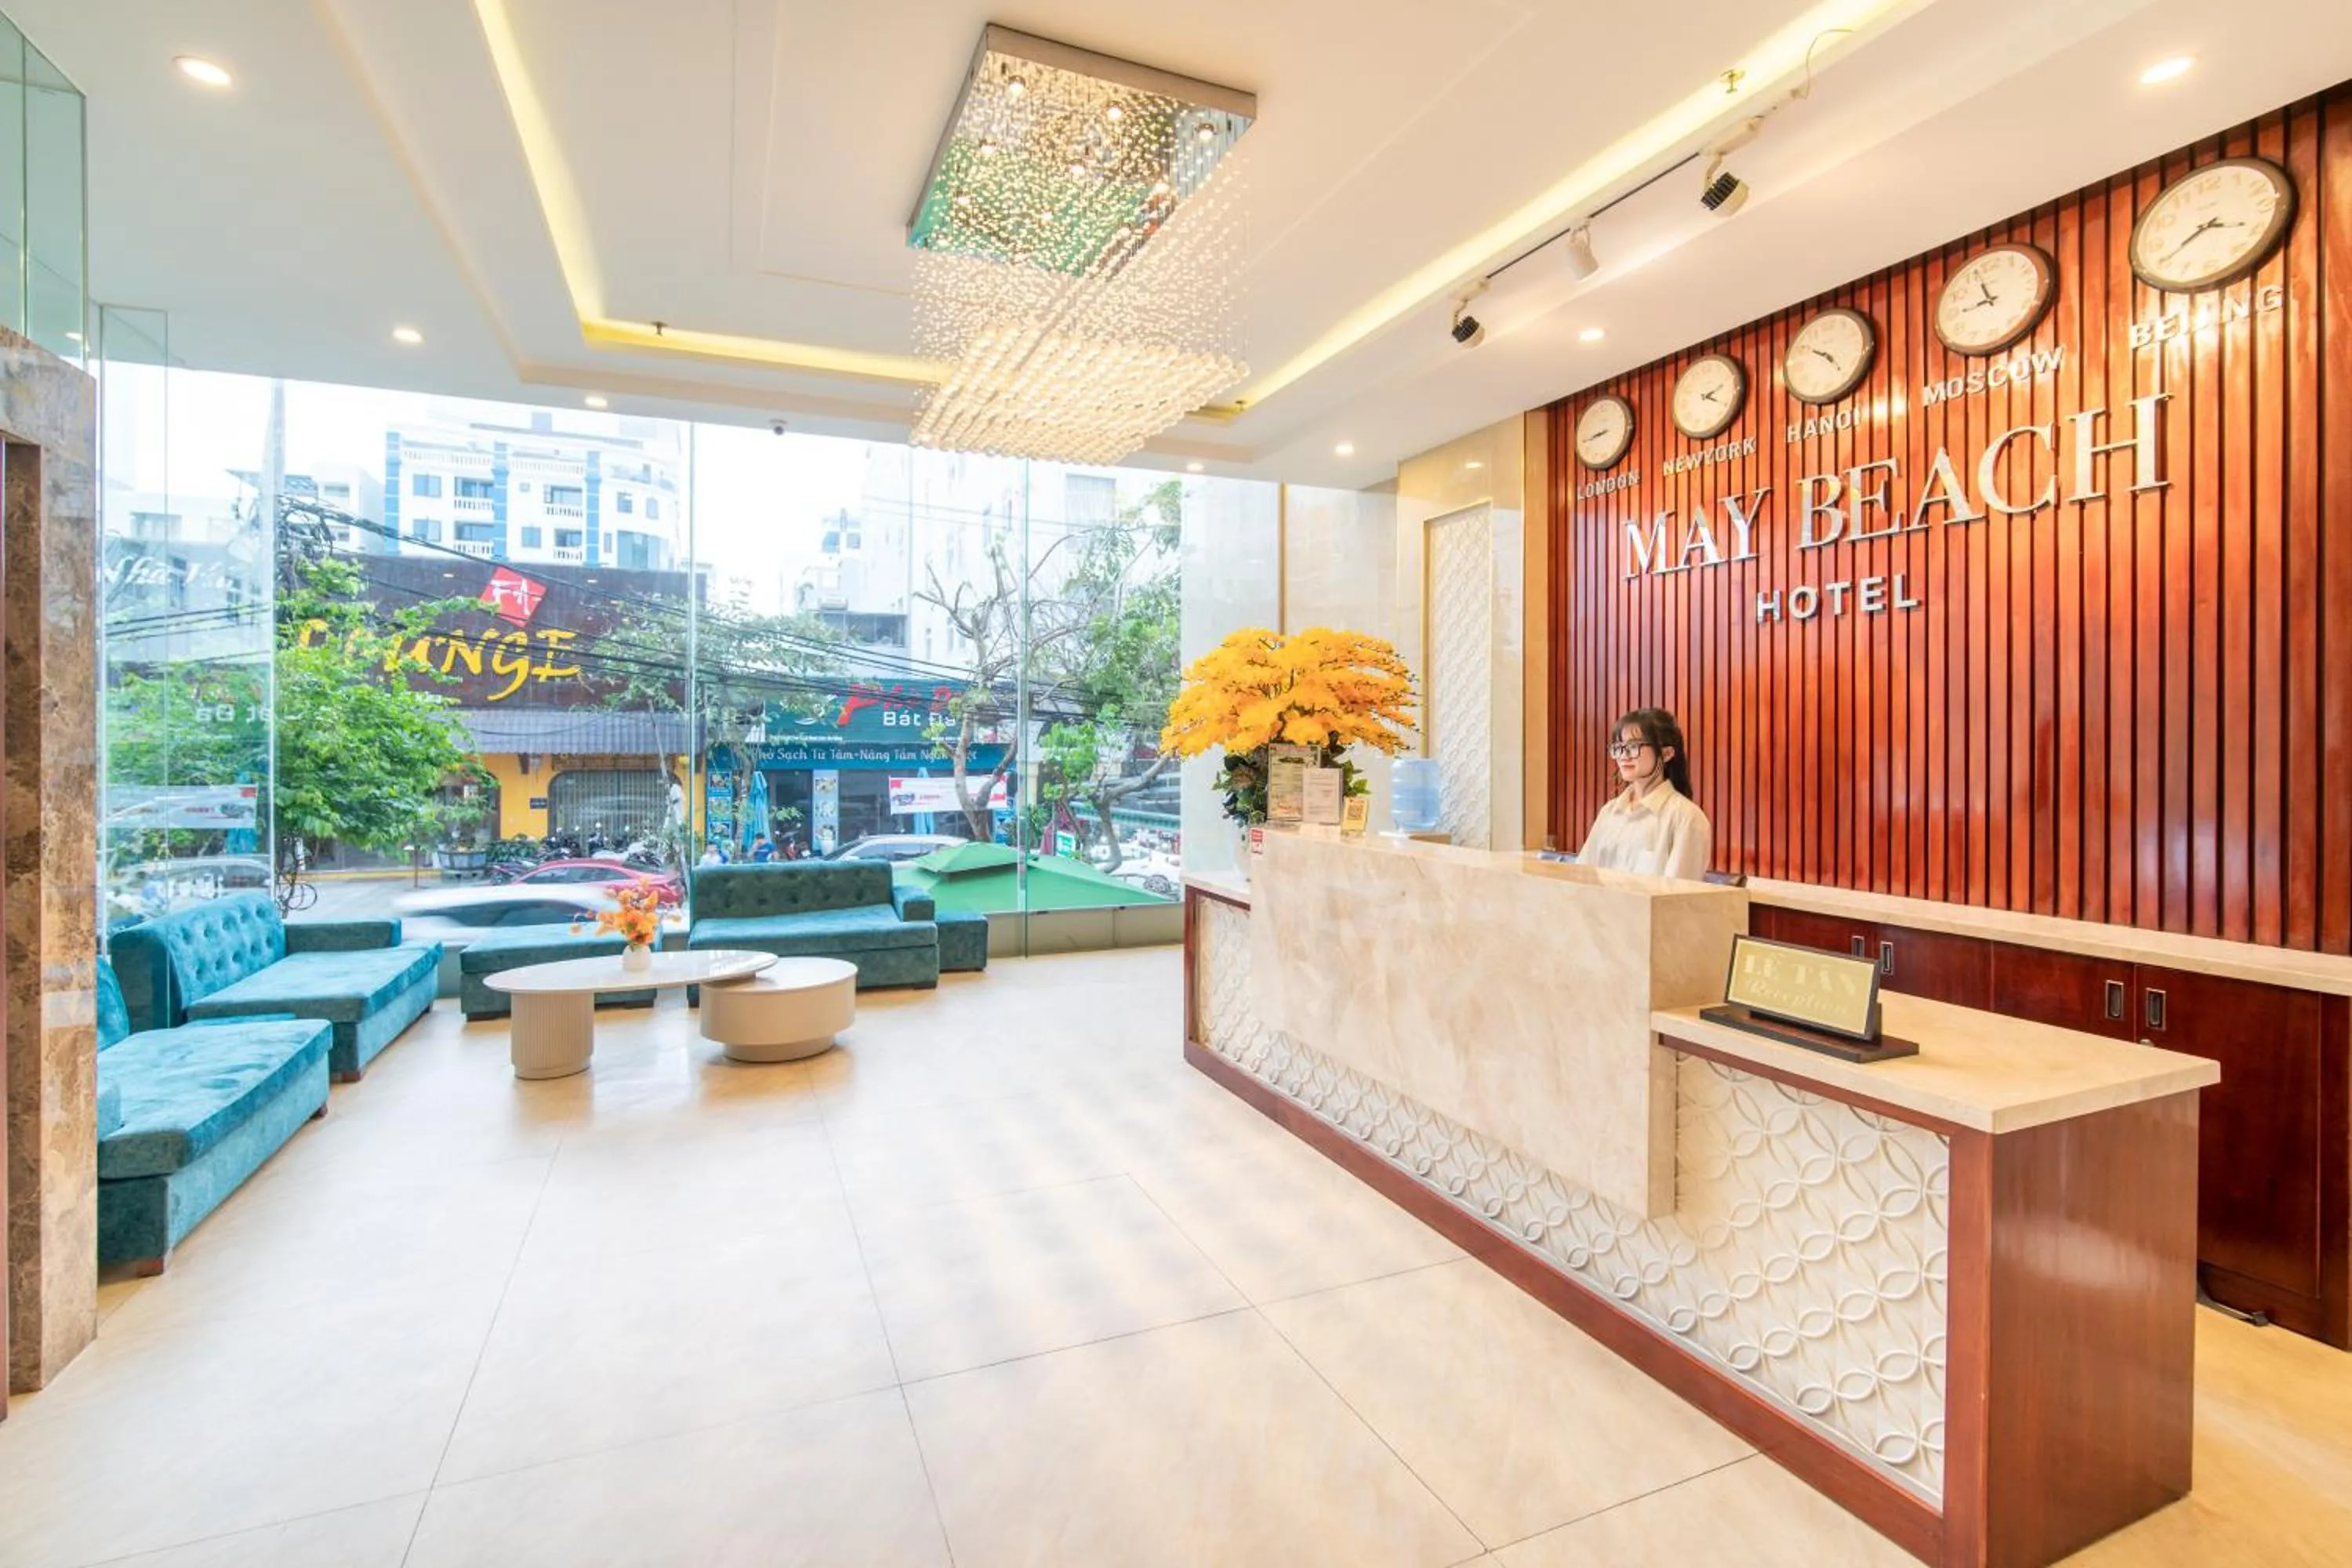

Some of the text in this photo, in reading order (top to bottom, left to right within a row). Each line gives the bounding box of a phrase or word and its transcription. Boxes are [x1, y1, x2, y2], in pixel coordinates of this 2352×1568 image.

[1922, 345, 2065, 407] MOSCOW
[1787, 406, 1860, 443] HANOI
[1663, 437, 1756, 477] NEWYORK
[1577, 470, 1640, 500] LONDON
[1624, 393, 2173, 581] MAY BEACH
[1756, 574, 1921, 623] HOTEL
[883, 710, 921, 727] Bát
